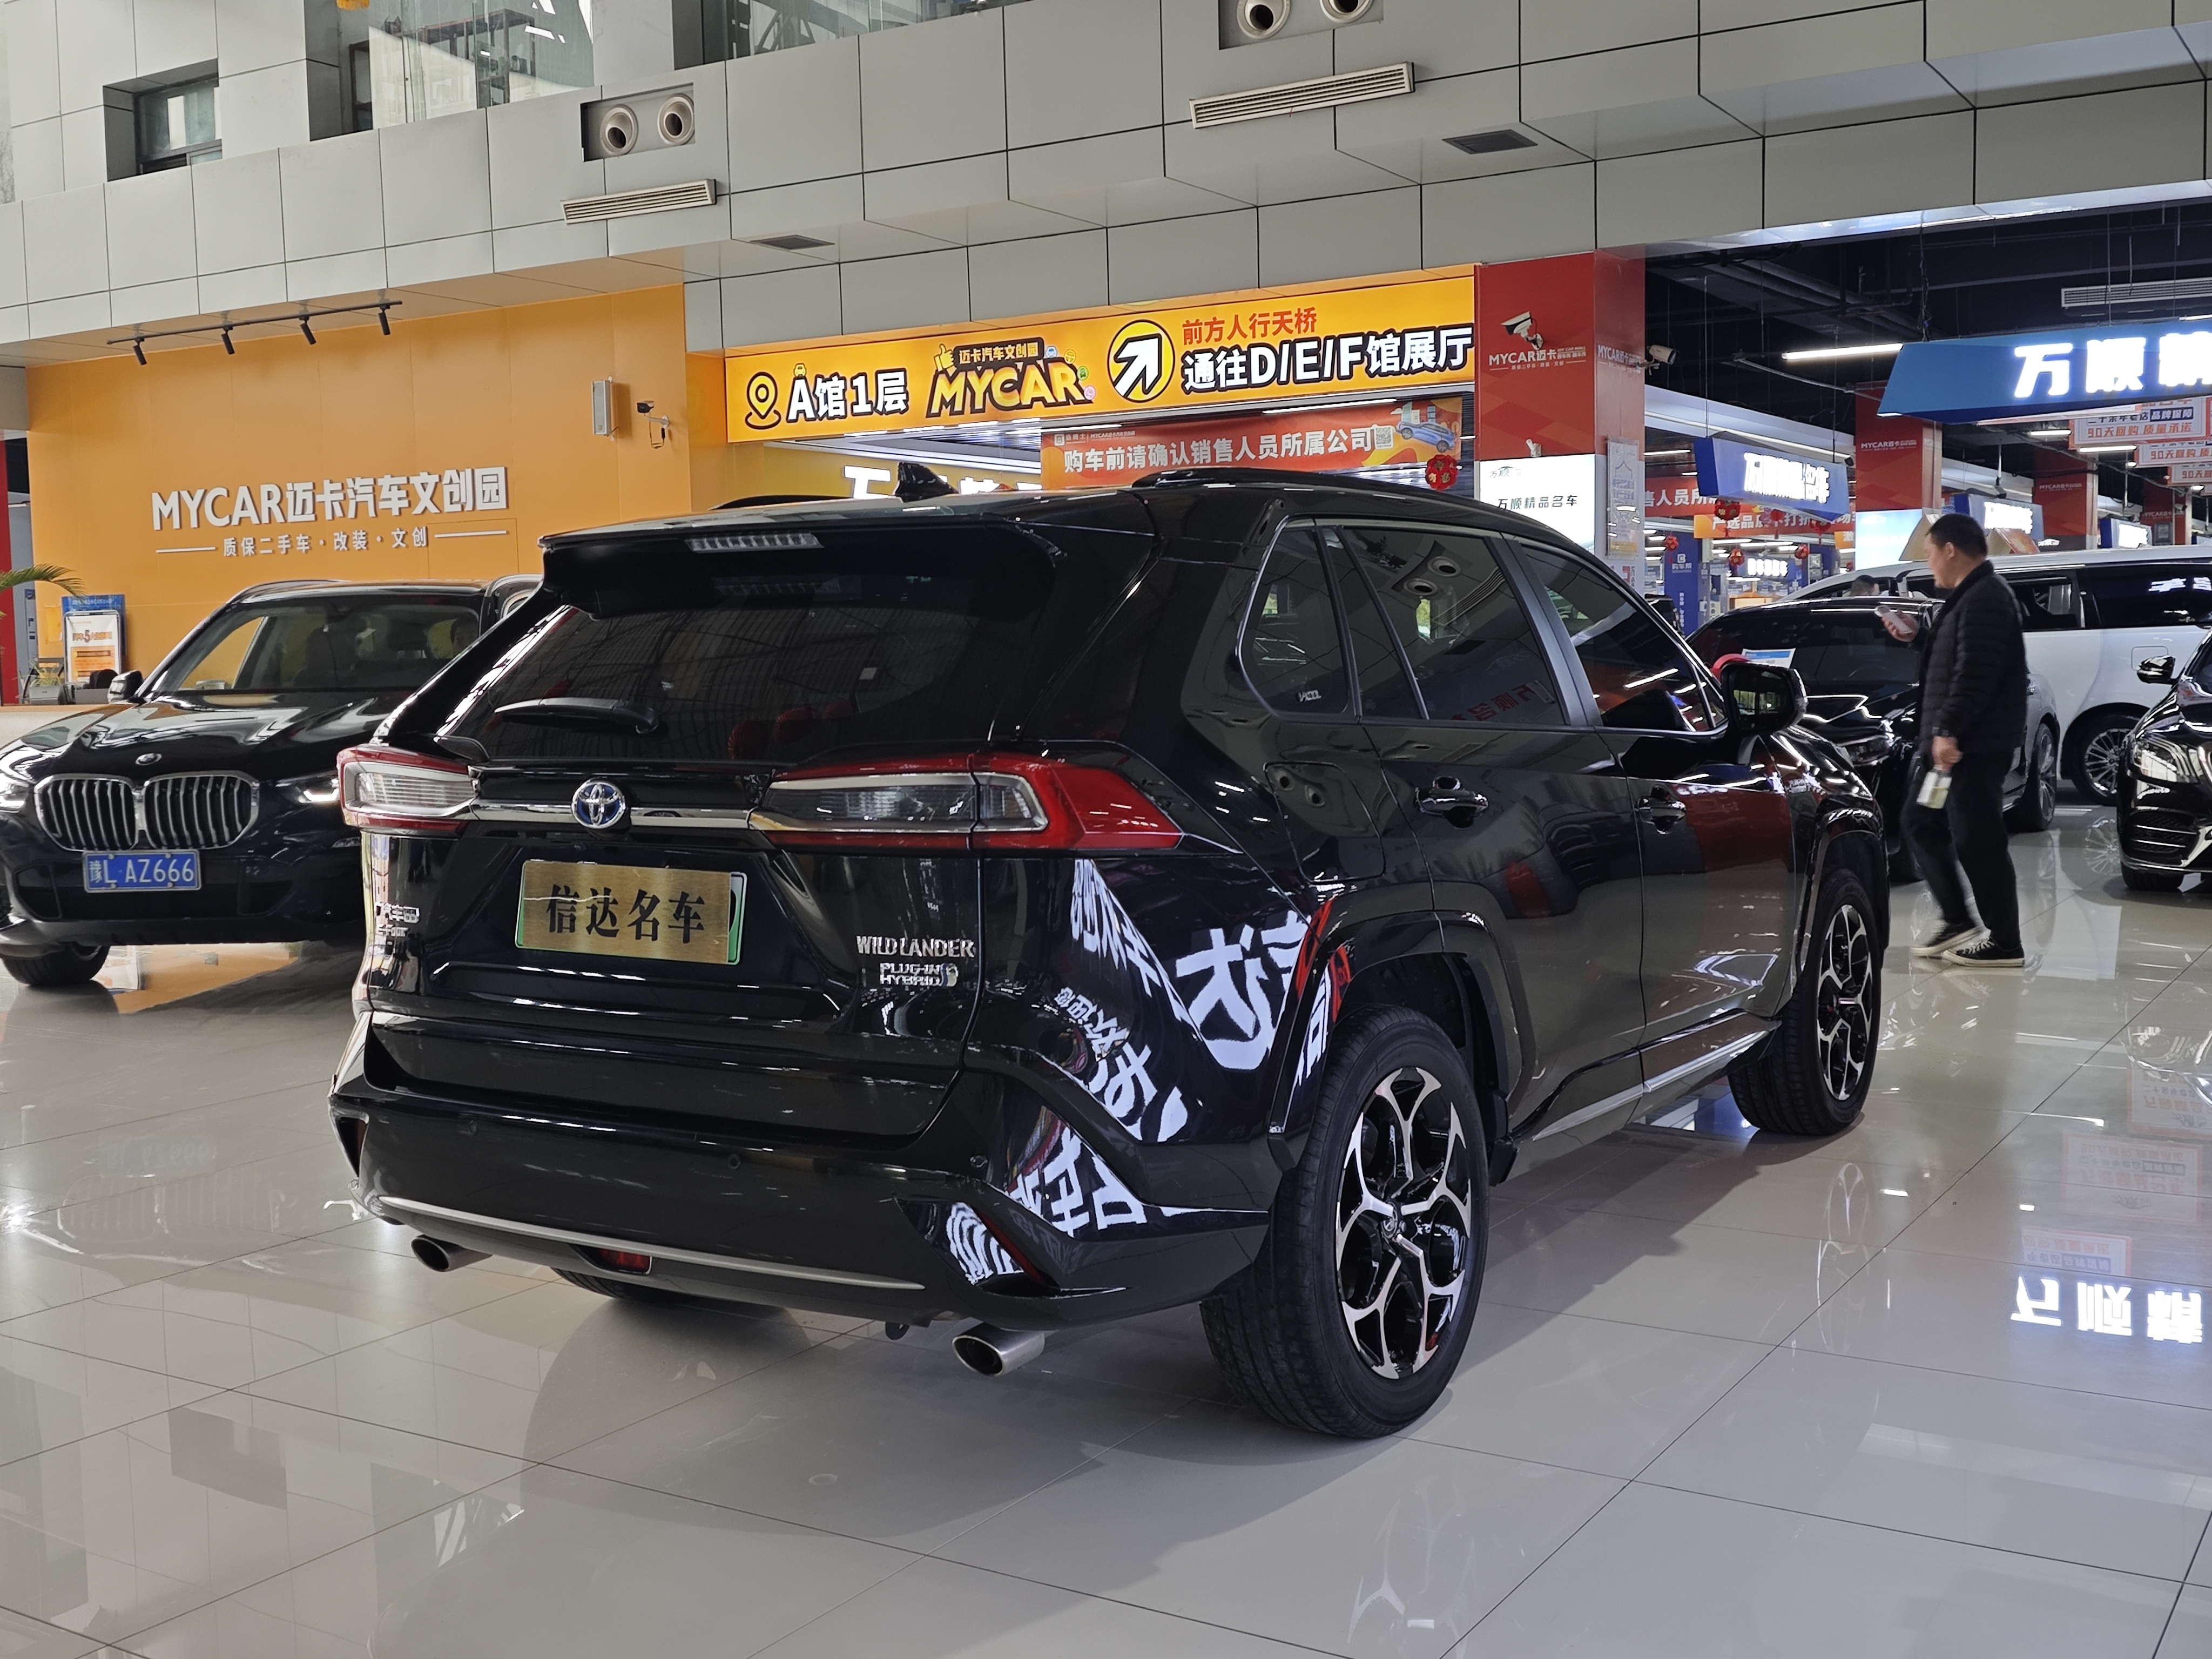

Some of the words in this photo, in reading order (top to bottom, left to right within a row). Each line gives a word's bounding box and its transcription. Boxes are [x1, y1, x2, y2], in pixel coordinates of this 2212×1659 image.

[1182, 307, 1317, 345] 前方人行天桥
[959, 342, 1039, 365] 迈卡汽车文创园
[1183, 327, 1472, 390] 通往D/E/F馆展厅
[787, 370, 908, 421] A馆1层
[929, 360, 1090, 417] MYCAR
[1064, 427, 1373, 473] 购车前请确认销售人员所属公司
[2088, 426, 2139, 438] 90天回购
[152, 466, 508, 530] MYCAR迈卡汽车文创园
[1498, 495, 1577, 510] 万顺精品名车
[547, 884, 705, 944] 信达名车
